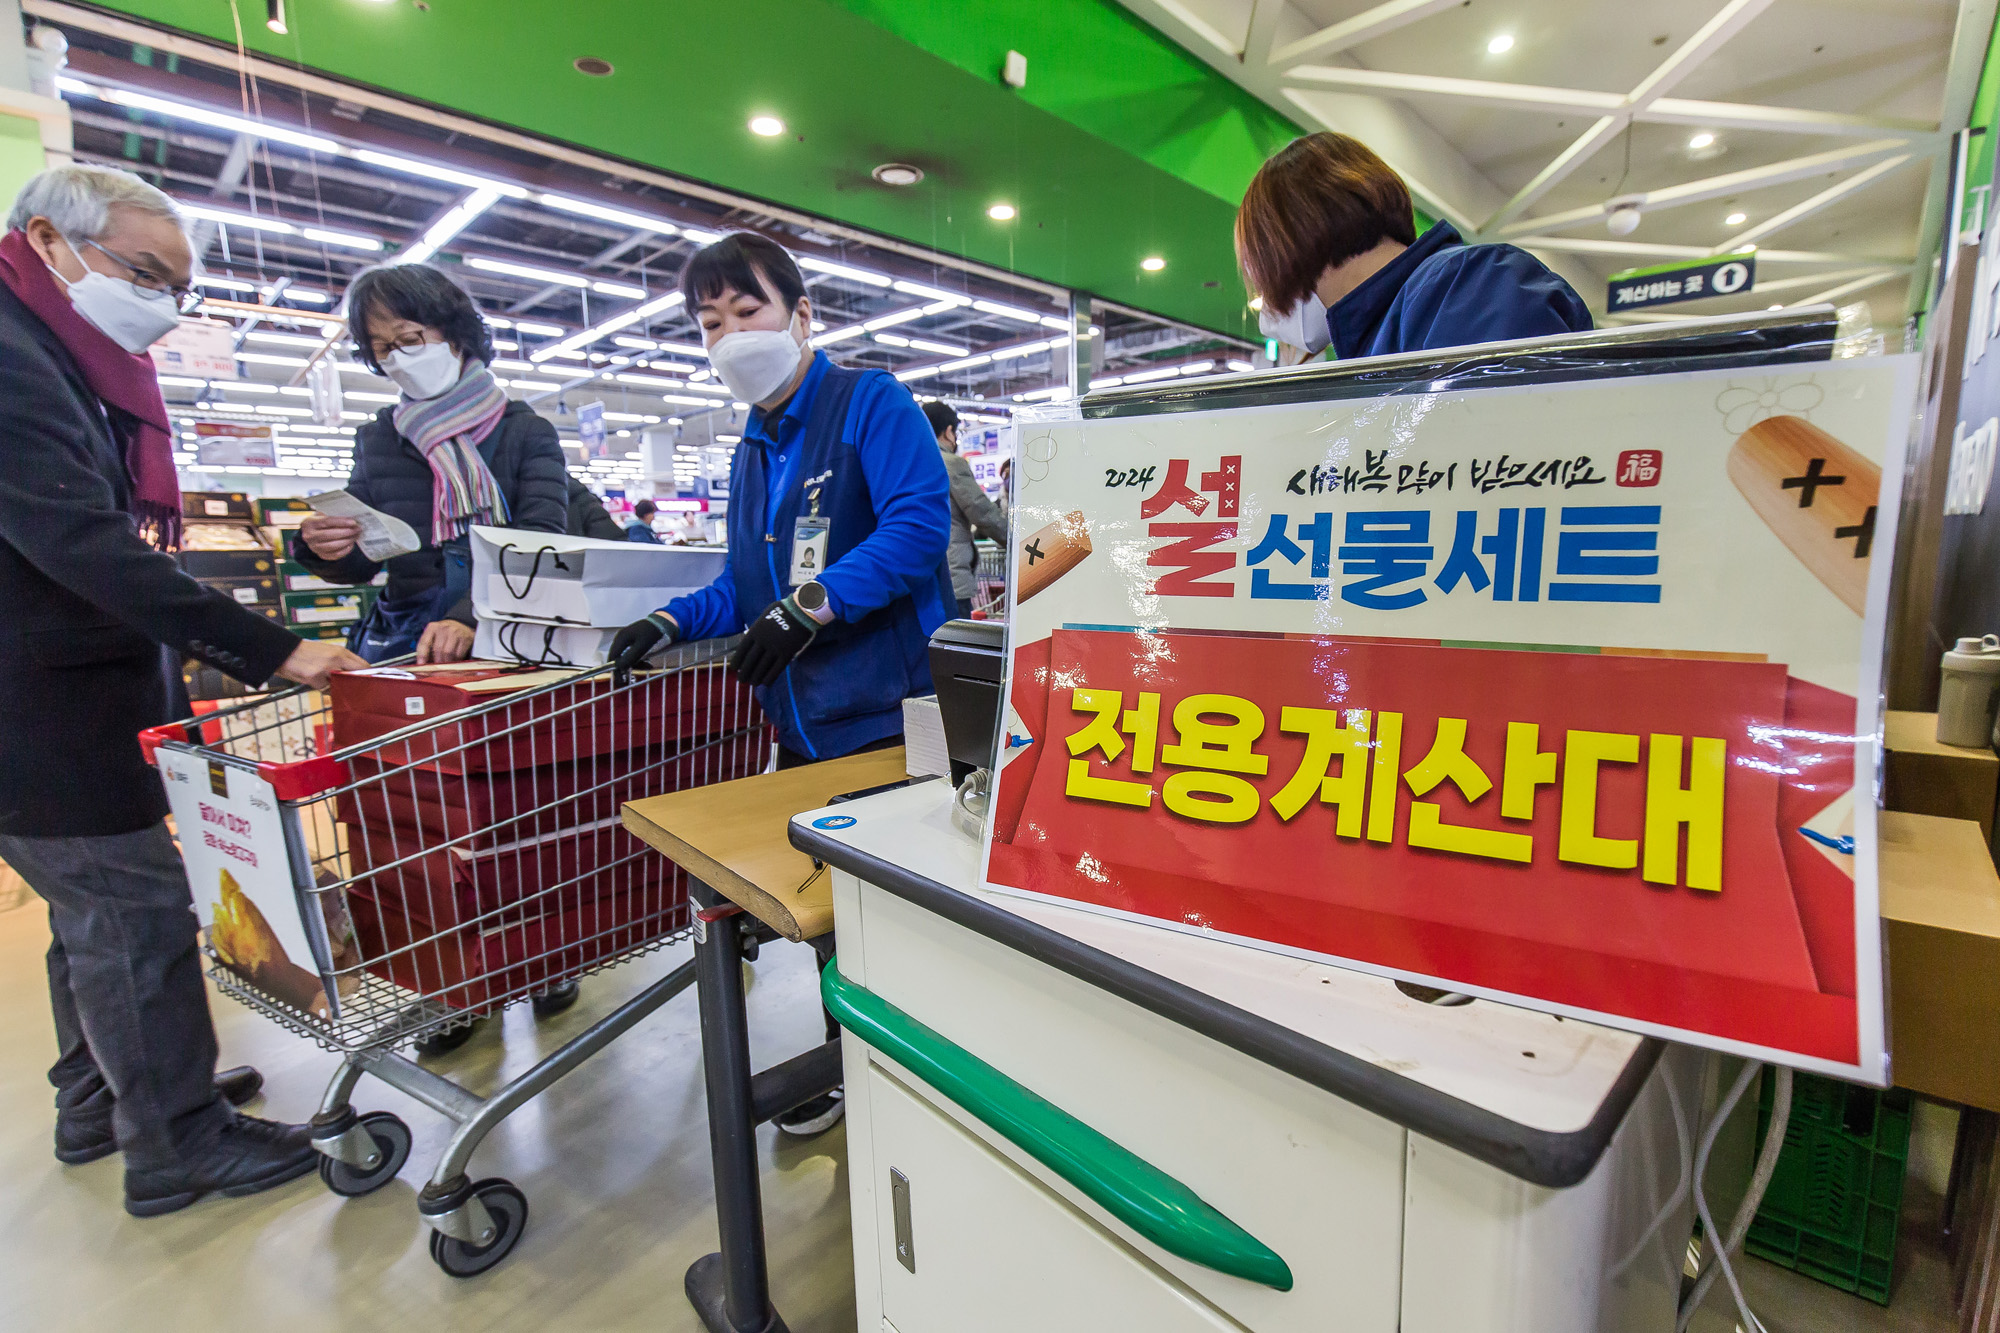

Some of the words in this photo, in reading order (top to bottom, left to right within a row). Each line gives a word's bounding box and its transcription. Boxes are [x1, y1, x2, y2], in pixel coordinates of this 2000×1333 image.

[1616, 280, 1682, 304] 계산하는
[1684, 274, 1703, 294] 곳
[1105, 466, 1154, 489] 2024
[1397, 462, 1457, 495] 많이
[1470, 455, 1606, 494] 받으세요
[1620, 453, 1658, 483] 福
[1140, 455, 1242, 598] 설
[1246, 505, 1662, 611] 선물세트
[1065, 687, 1726, 892] 전용계산대
